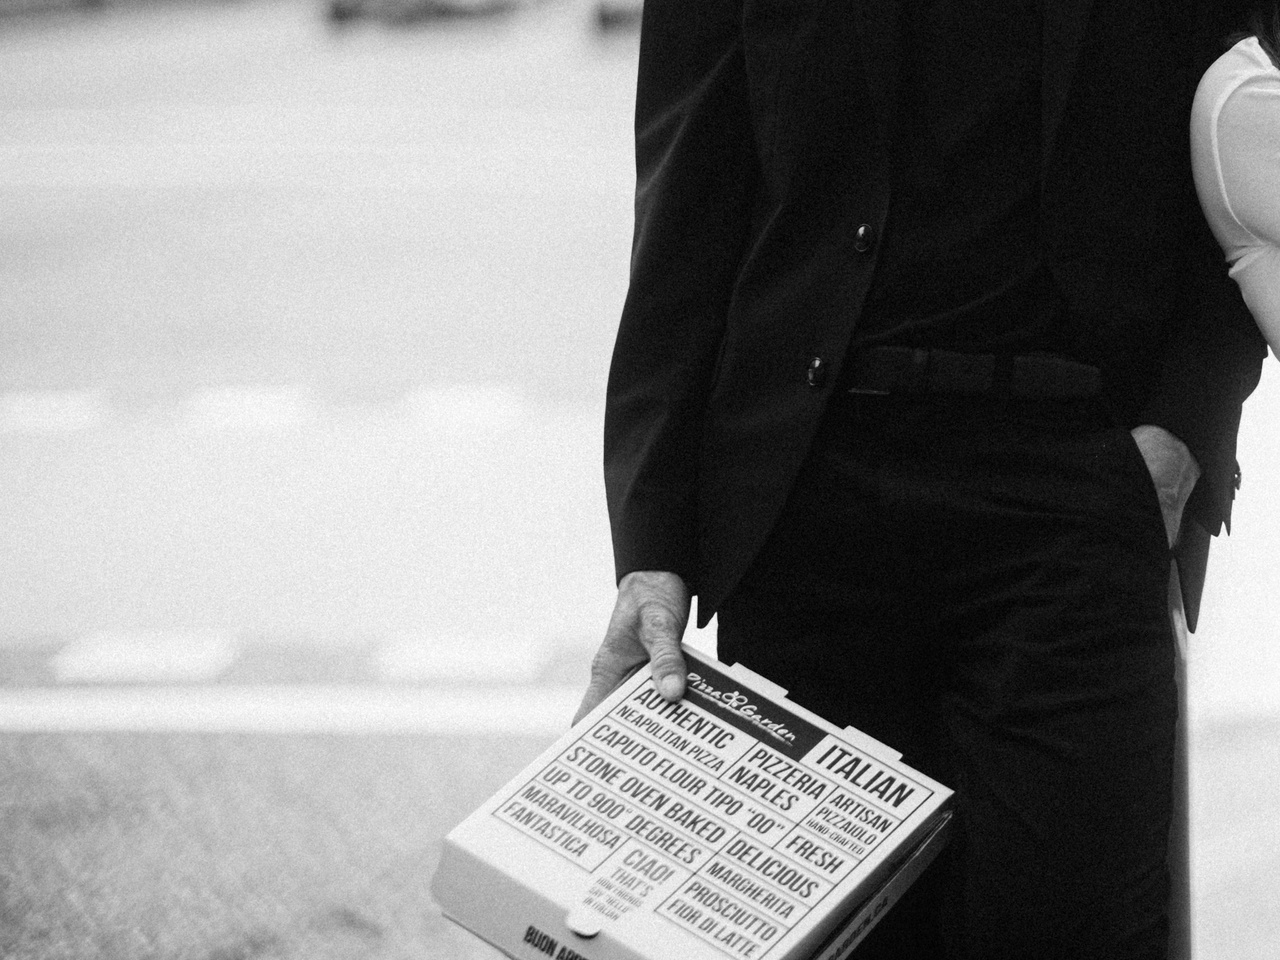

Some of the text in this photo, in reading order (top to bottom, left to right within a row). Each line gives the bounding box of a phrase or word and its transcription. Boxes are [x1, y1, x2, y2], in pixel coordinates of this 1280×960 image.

[633, 688, 735, 749] AUTHENTIC
[687, 672, 796, 741] Pizza Garden
[616, 705, 726, 772] NEAPOLITAN PIZZA
[566, 746, 726, 844] STONE OVEN BAKED
[592, 724, 657, 767] CAPUTO
[651, 758, 707, 796] FLOUR
[703, 785, 744, 816] TIPO
[729, 766, 800, 812] NAPLES
[748, 749, 827, 801] PIZZERIA
[816, 744, 915, 809] ITALIAN
[503, 801, 589, 857] FANTASTICA
[521, 785, 622, 850] MARAVILHOSA
[542, 766, 571, 786] UP
[566, 779, 593, 801] TO
[625, 815, 702, 864] DEGREES
[816, 806, 878, 846] PIZZAIOLO
[829, 793, 893, 834] ARTISAN
[611, 866, 654, 898] THAT'S
[623, 849, 677, 886] CIAO!
[726, 839, 819, 898] DELICIOUS
[785, 835, 845, 875] FRESH
[683, 881, 778, 942] PROSCIUTTO
[706, 862, 795, 919] MARGHERITA
[524, 925, 558, 957] BUON
[666, 898, 761, 957] FIOR DI LATTE
